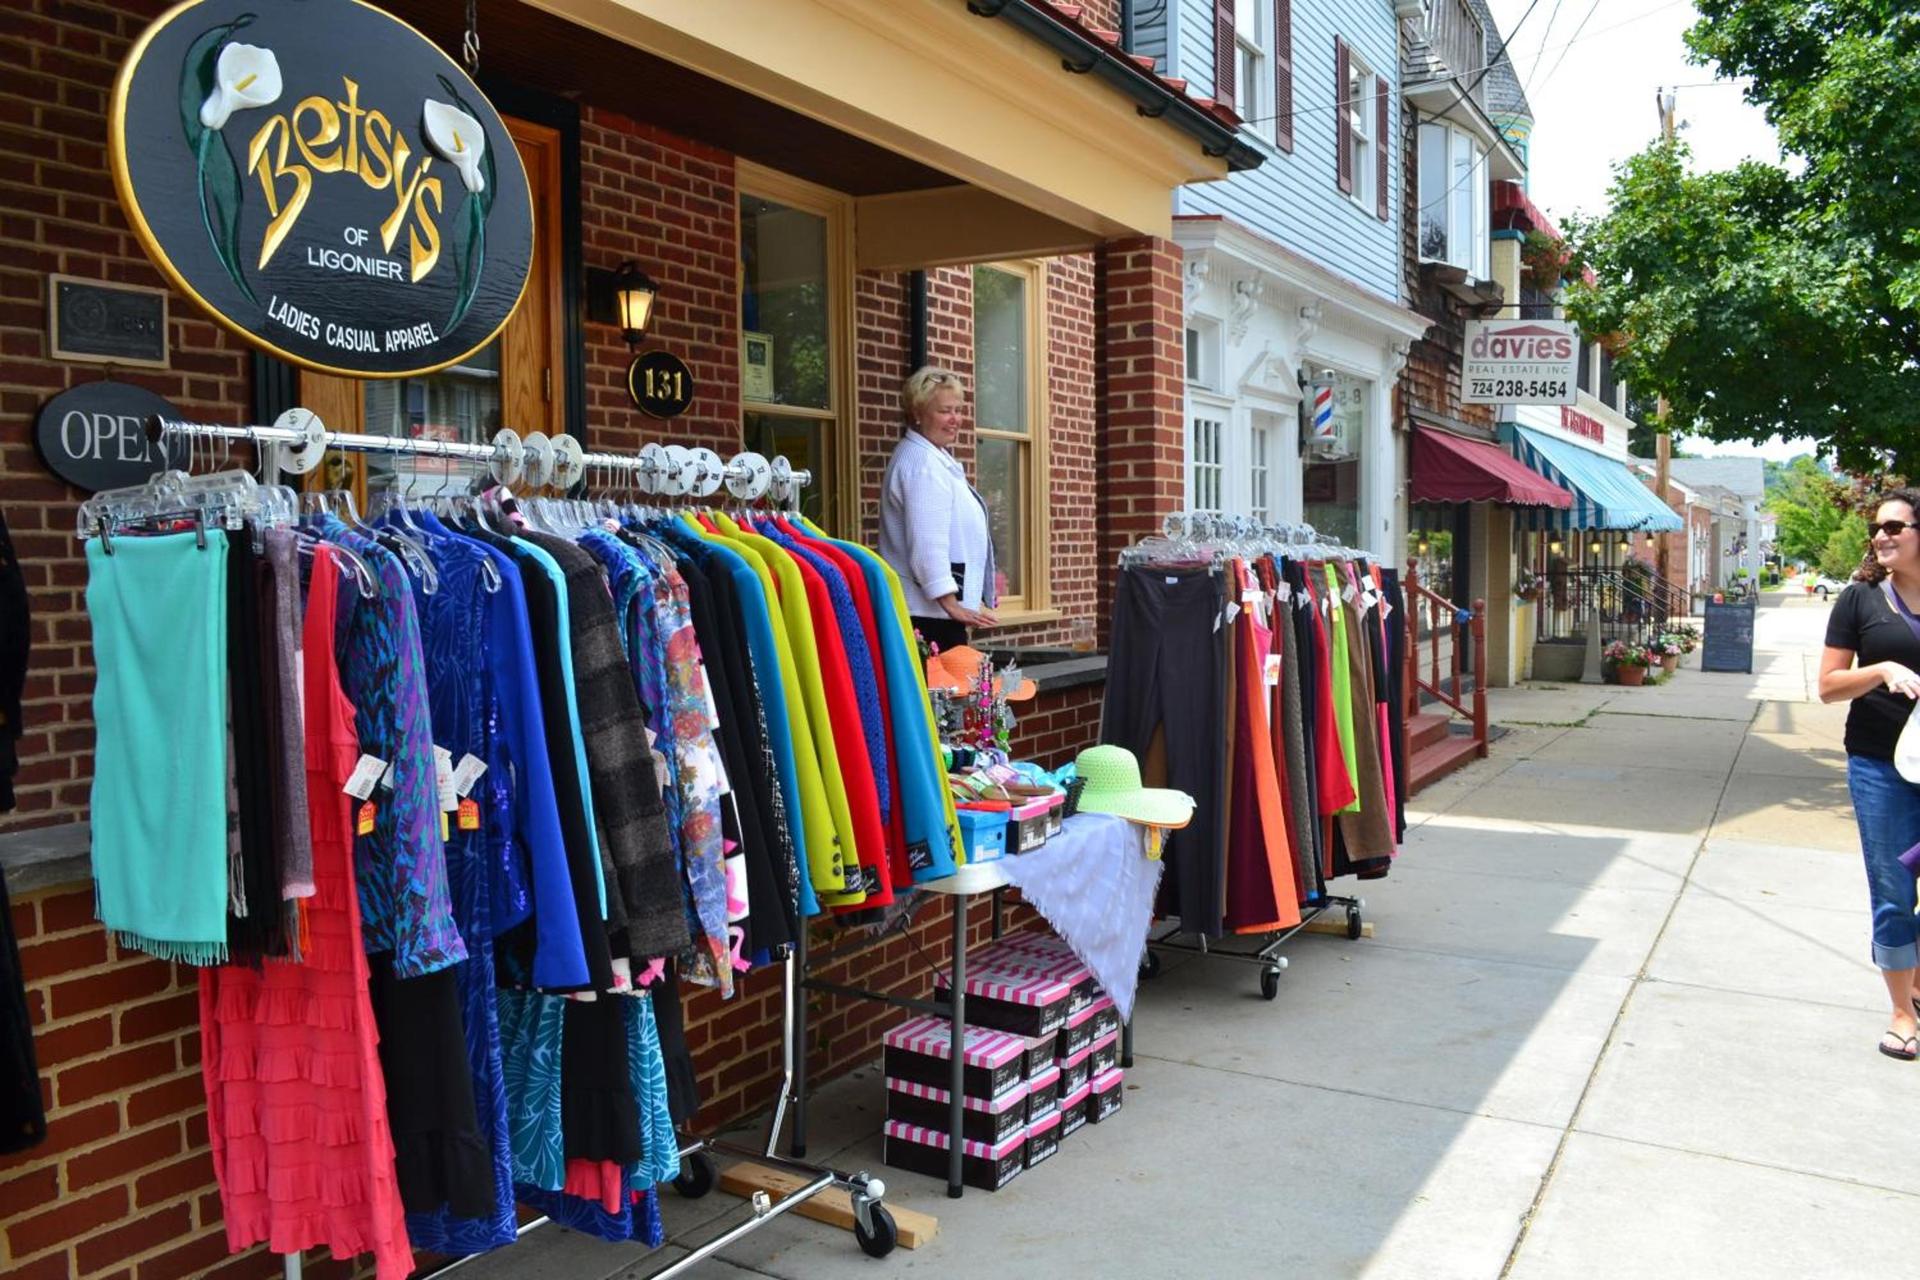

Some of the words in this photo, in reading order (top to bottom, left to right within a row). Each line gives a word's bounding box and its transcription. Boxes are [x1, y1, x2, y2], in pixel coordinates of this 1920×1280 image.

[249, 76, 443, 284] Betsy's
[344, 227, 369, 247] OF
[307, 246, 404, 281] LIGONIER
[267, 295, 321, 341] LADIES
[325, 323, 381, 353] CASUAL
[385, 321, 440, 353] APPAREL
[1471, 326, 1572, 360] davies
[645, 367, 683, 402] 131
[1469, 365, 1495, 374] REAL
[1502, 365, 1540, 375] ESTATE
[1547, 365, 1569, 375] INC
[1472, 382, 1494, 395] 724
